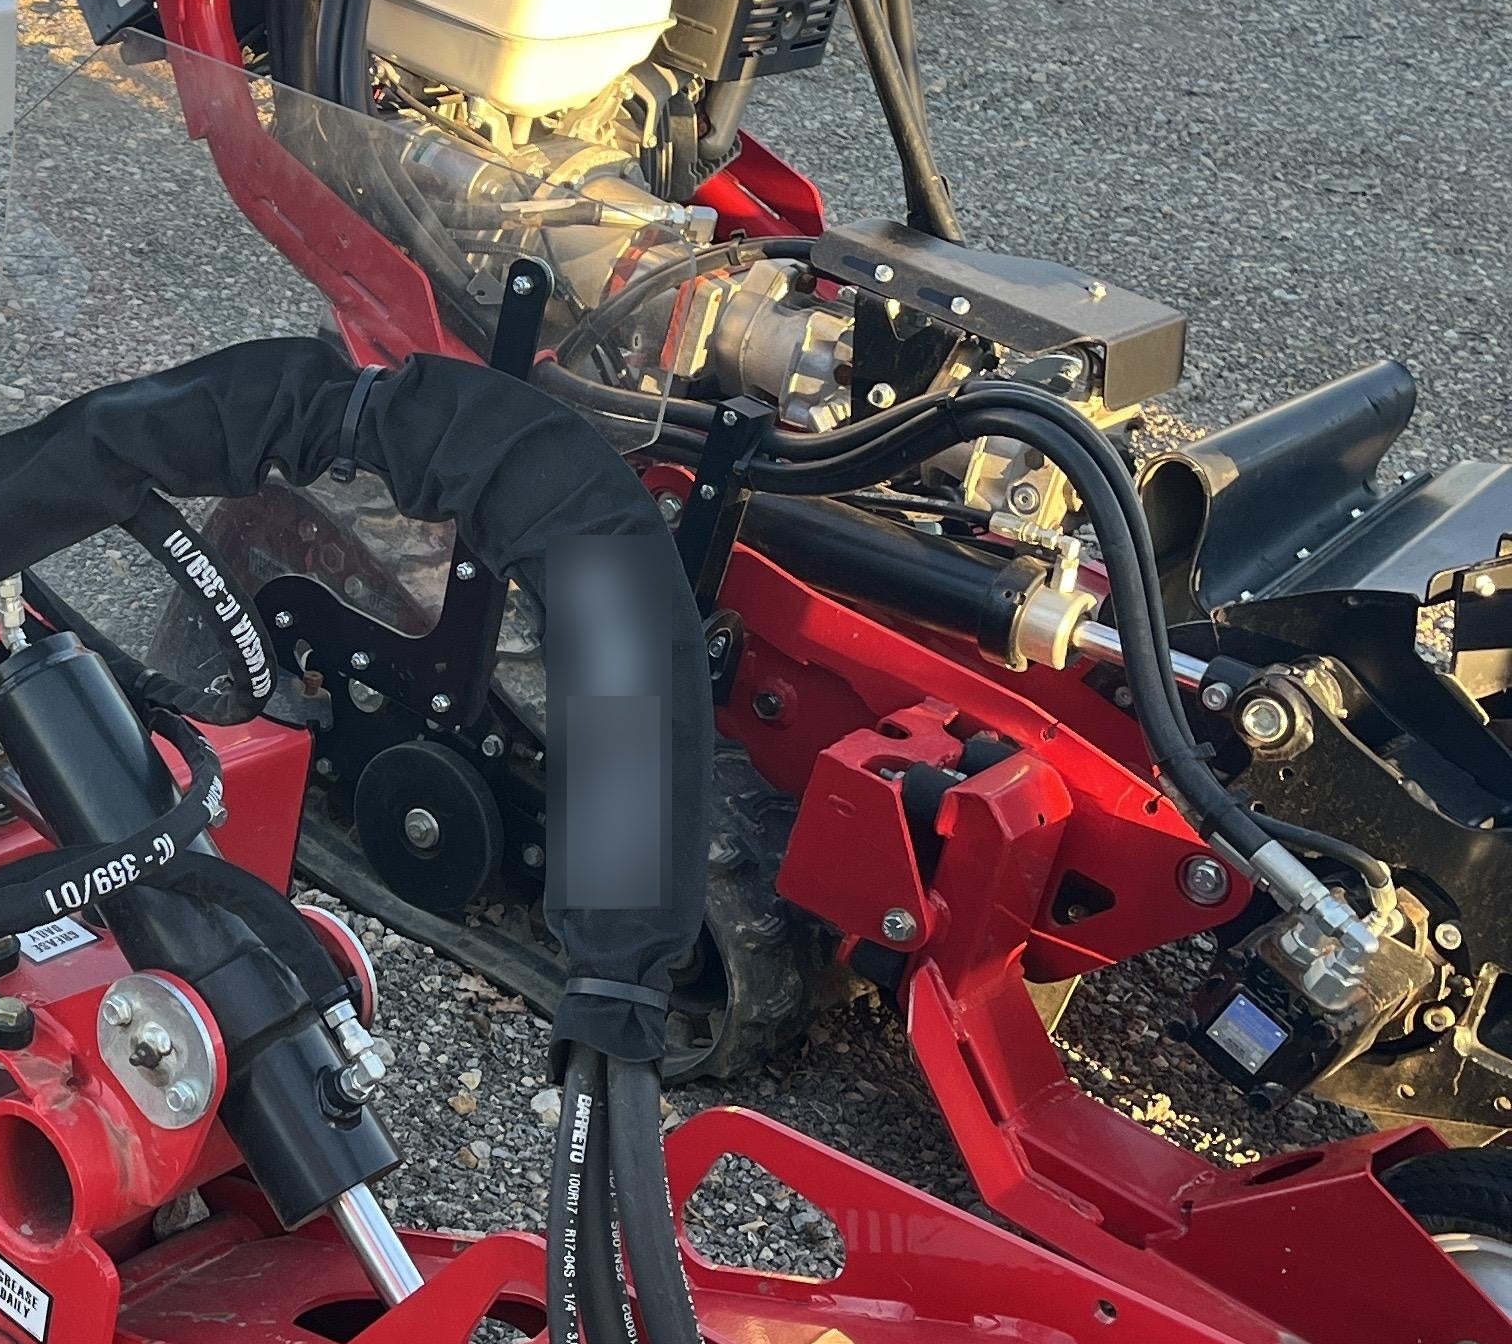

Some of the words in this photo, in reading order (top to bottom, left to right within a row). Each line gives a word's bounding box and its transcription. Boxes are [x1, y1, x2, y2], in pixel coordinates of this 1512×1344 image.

[230, 612, 266, 674] MSHA
[28, 923, 64, 943] DAILY
[37, 930, 81, 954] GREASE
[569, 1092, 593, 1164] BARRETO
[565, 1172, 581, 1216] 100R17
[563, 1227, 577, 1279] R17-04S
[0, 1286, 31, 1319] DAILY
